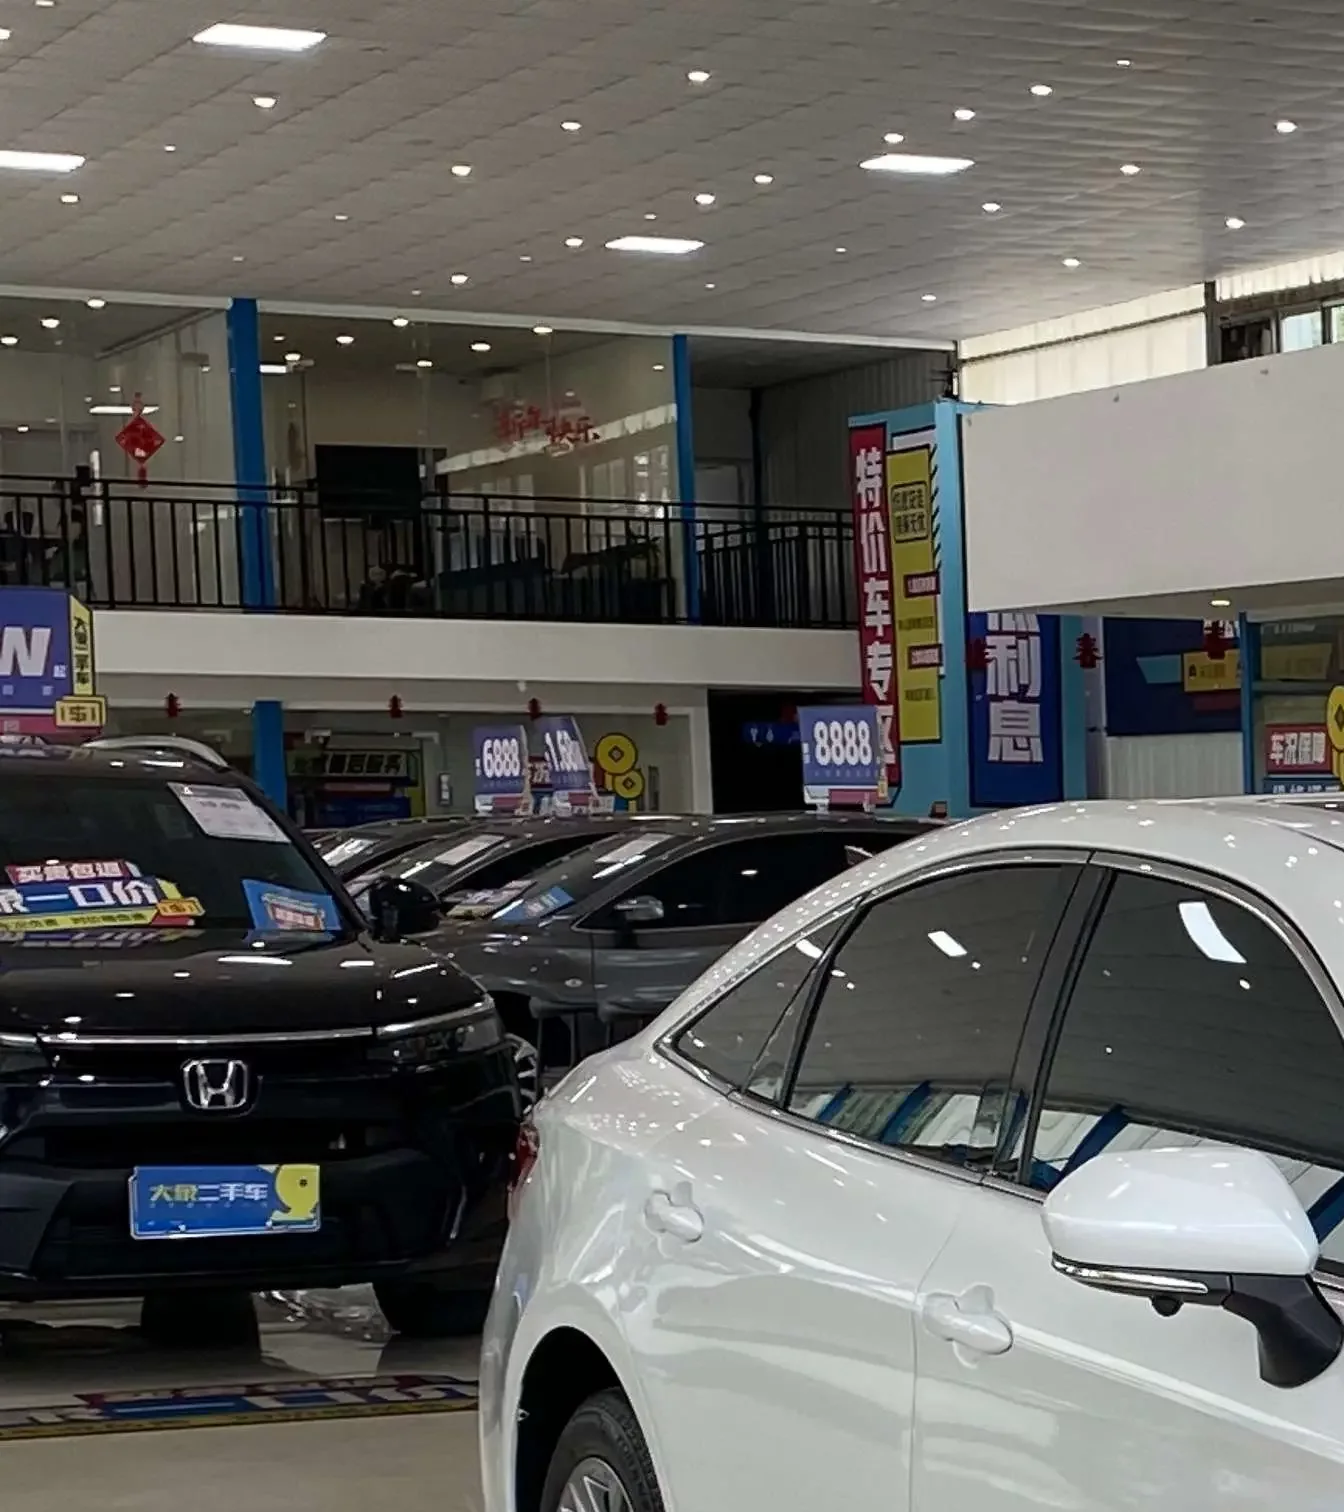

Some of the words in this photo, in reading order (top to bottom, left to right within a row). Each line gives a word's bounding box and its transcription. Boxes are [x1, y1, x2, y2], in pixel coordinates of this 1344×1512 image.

[482, 738, 521, 778] 6888
[814, 720, 872, 766] 8888
[150, 1183, 268, 1202] 大象二手车
